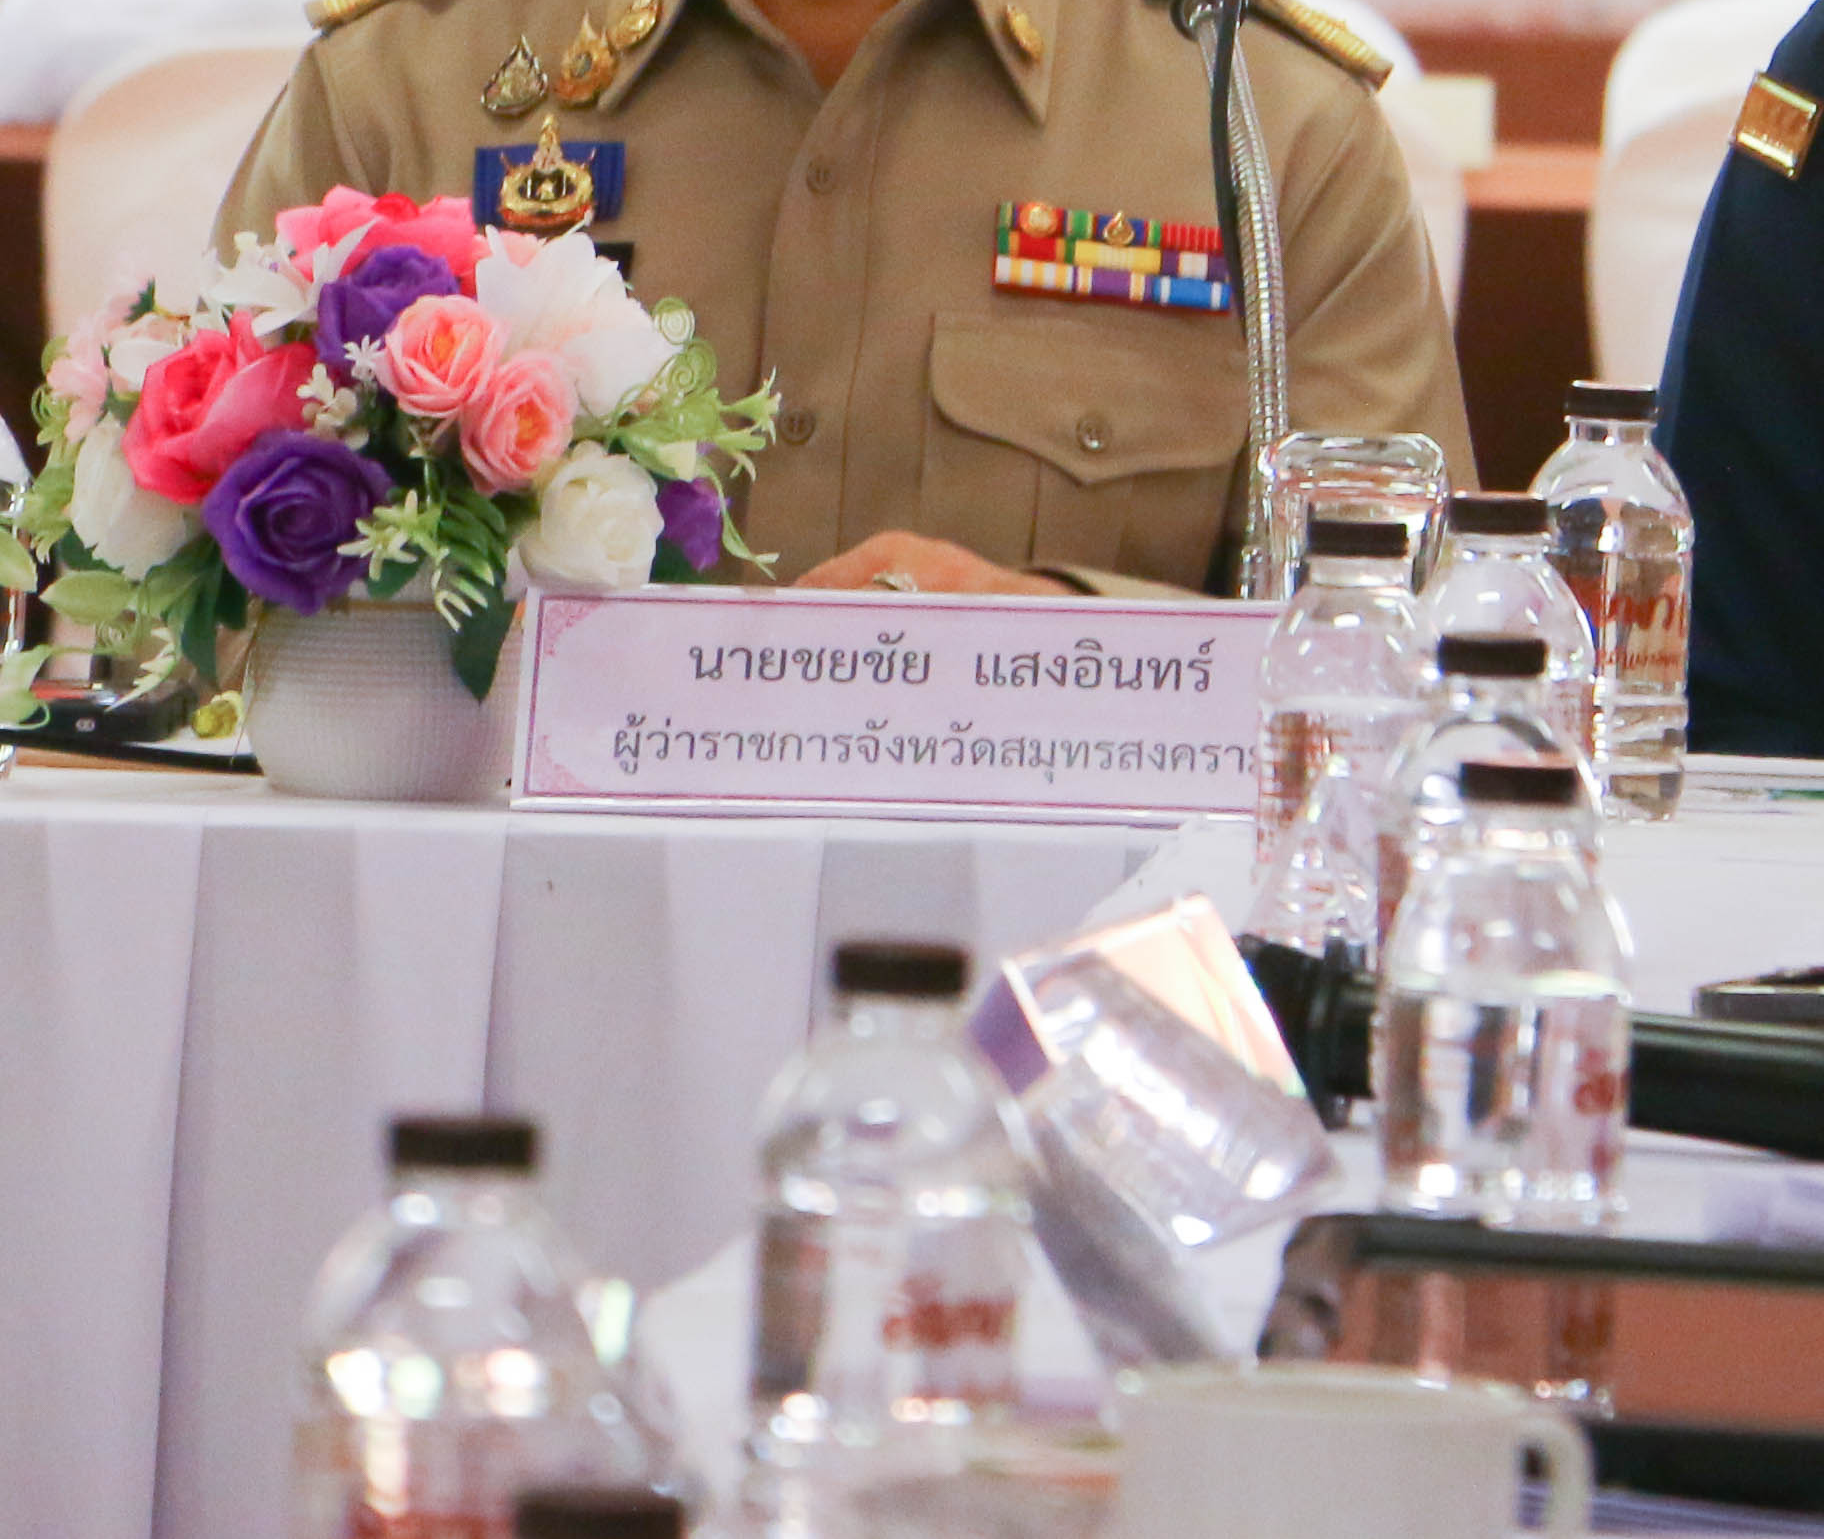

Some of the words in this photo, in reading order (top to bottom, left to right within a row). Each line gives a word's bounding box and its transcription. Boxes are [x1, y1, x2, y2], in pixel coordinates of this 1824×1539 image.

[687, 632, 932, 685] นายชยชัย
[973, 637, 1214, 693] แสงอินทร์
